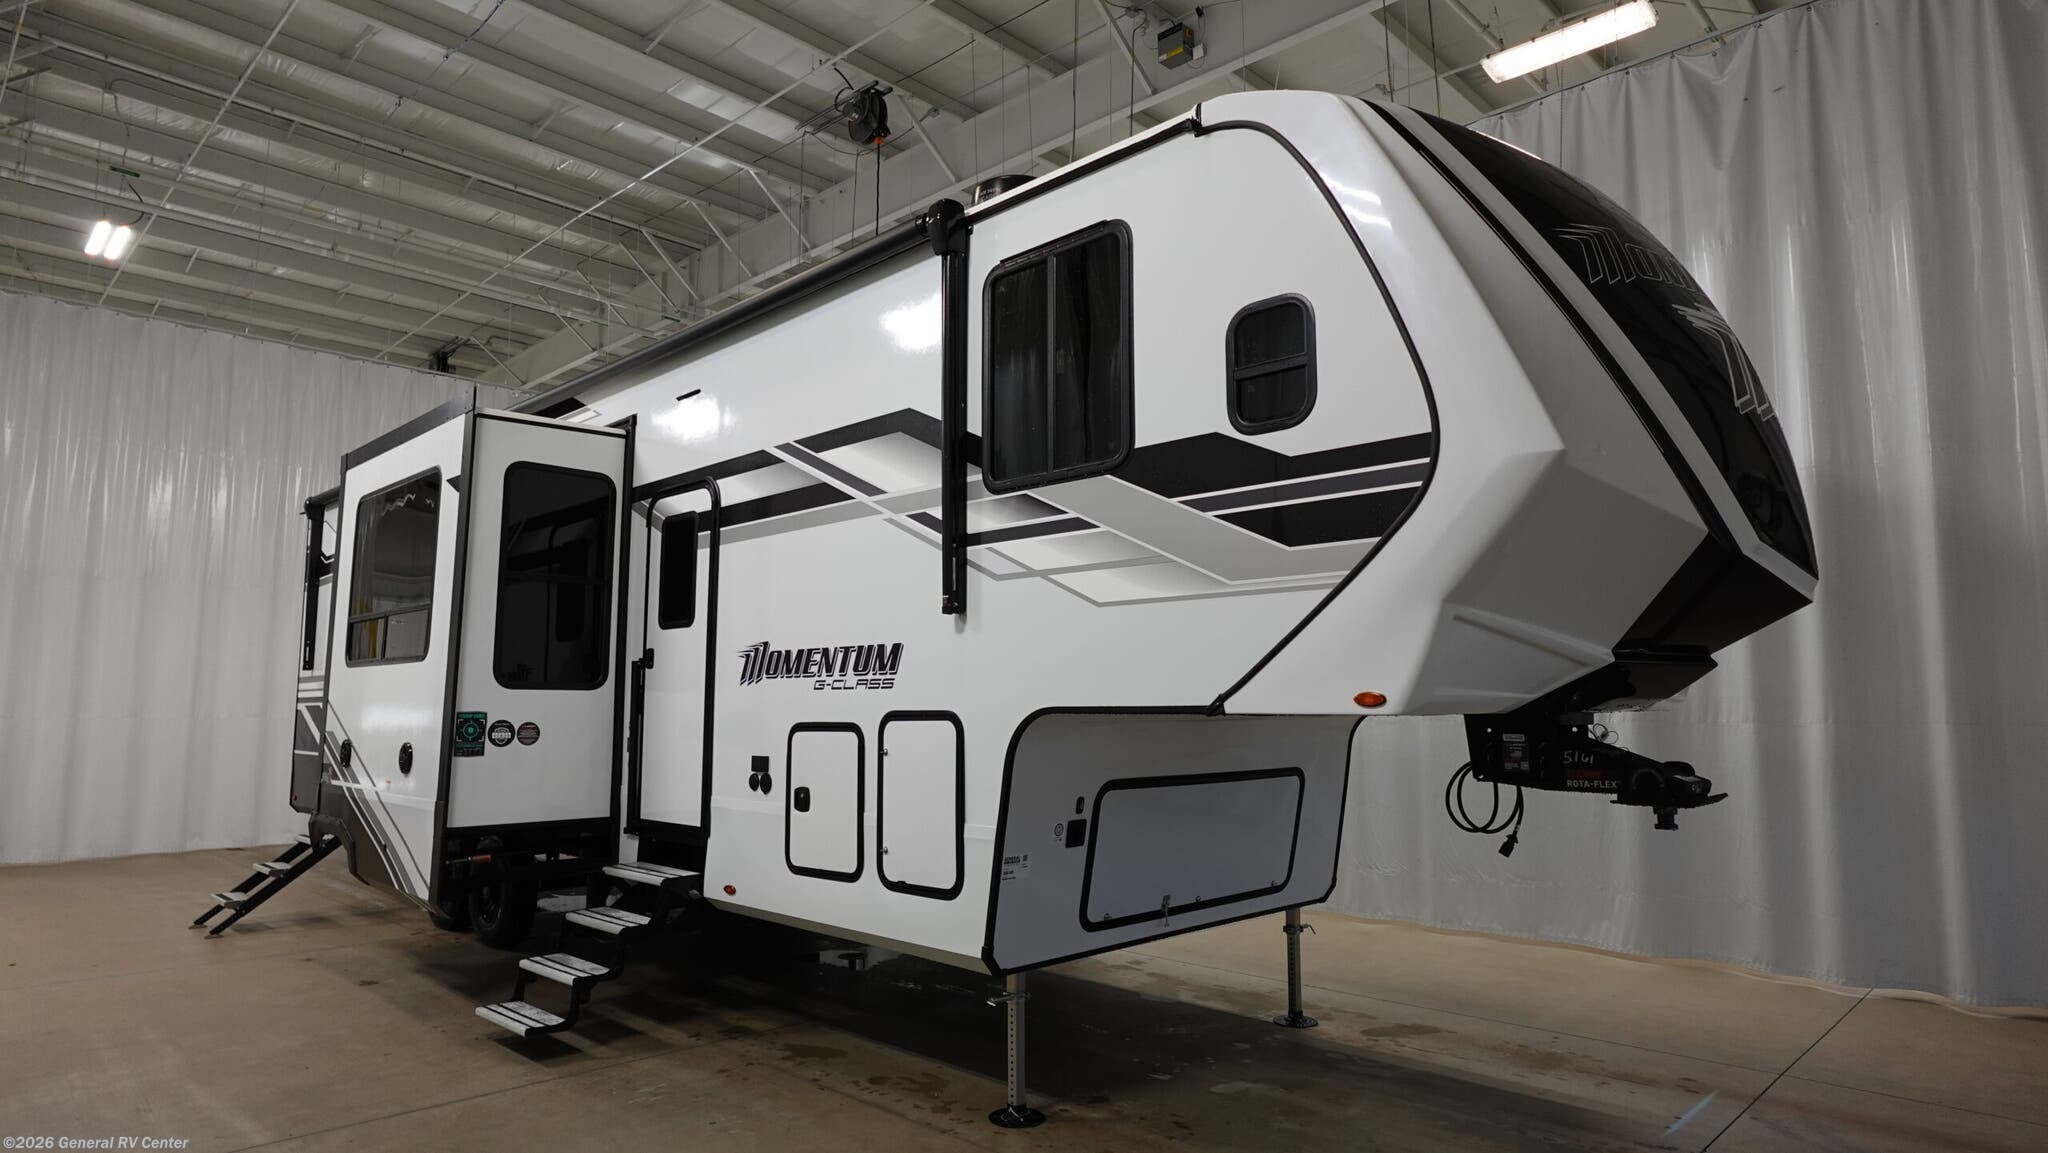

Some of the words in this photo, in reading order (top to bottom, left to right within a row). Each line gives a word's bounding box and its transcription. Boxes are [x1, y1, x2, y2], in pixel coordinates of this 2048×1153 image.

[736, 641, 904, 686] MOMENTUM
[813, 678, 895, 691] G-CLASS
[1566, 779, 1617, 789] ROTA-FLEX
